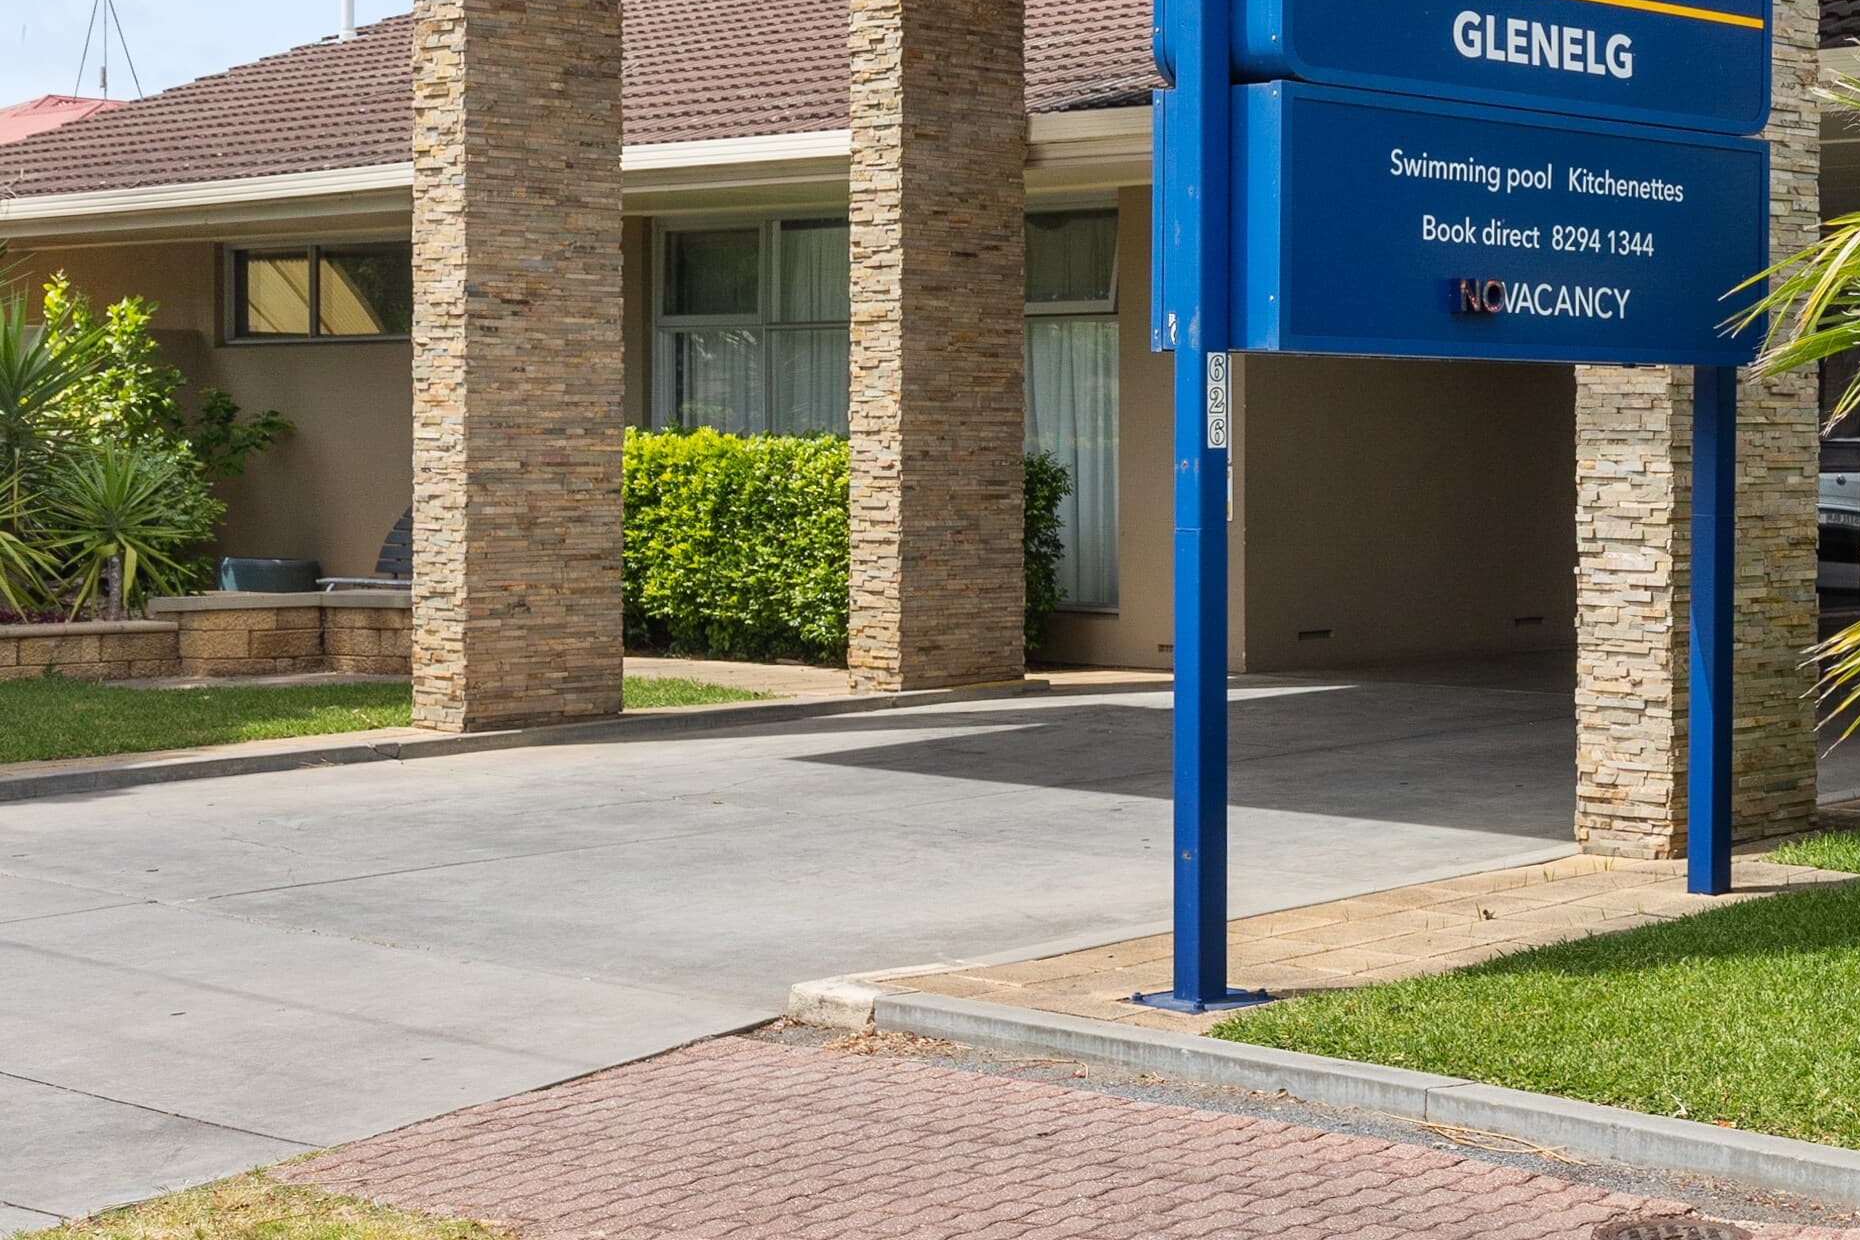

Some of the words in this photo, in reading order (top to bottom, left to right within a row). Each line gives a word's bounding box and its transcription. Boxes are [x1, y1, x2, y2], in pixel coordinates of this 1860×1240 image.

[1453, 10, 1634, 79] GLENELG
[1390, 148, 1501, 193] Swimming
[1507, 163, 1553, 194] pool
[1568, 167, 1684, 202] Kitchenettes
[1422, 214, 1477, 244] Book
[1482, 218, 1541, 249] direct
[1551, 224, 1601, 253] 8294
[1607, 230, 1654, 257] 1344
[1501, 281, 1631, 319] VACANCY
[1208, 354, 1225, 446] 626
